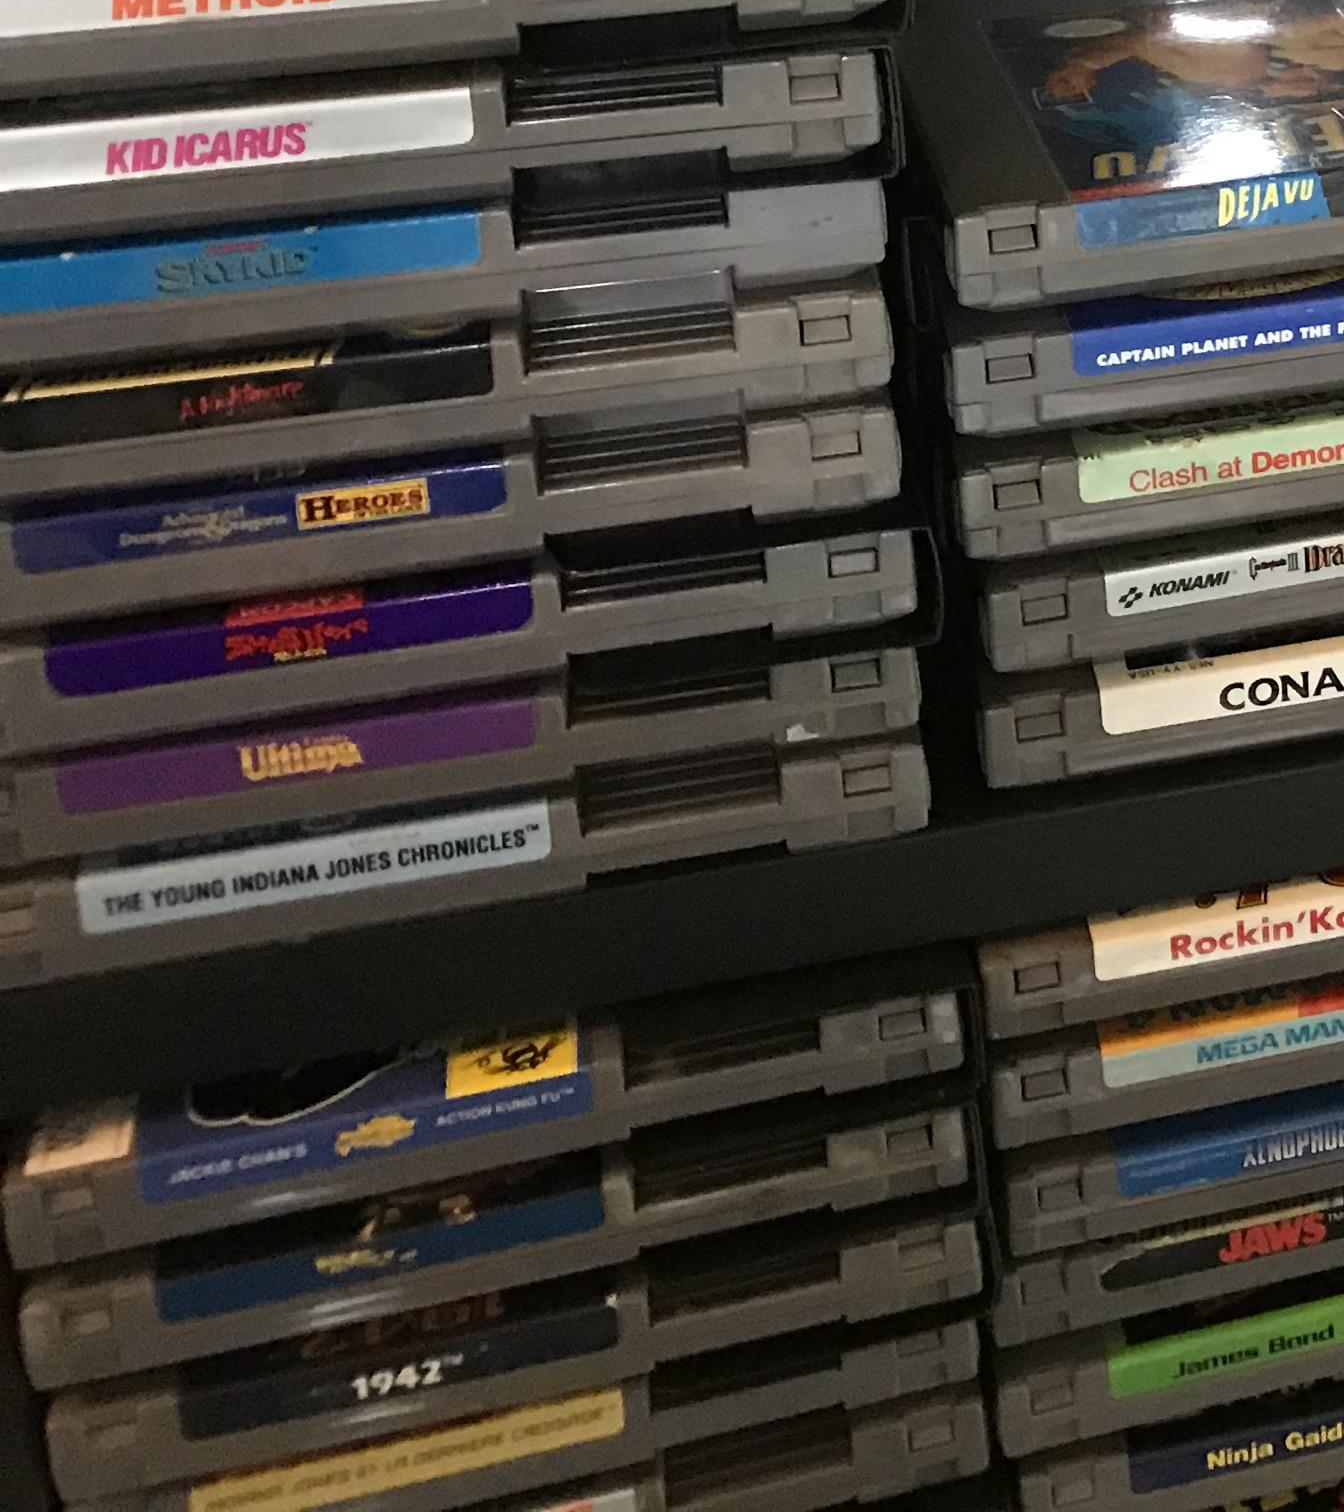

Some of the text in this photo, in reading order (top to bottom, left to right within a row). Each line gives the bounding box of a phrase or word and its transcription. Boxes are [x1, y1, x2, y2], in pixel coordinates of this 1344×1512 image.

[106, 123, 307, 175] KID ICARUS
[1284, 178, 1314, 204] VU
[1097, 345, 1174, 369] CAPTAIN
[1181, 335, 1248, 357] PLANET
[1254, 328, 1293, 347] AND
[1299, 323, 1331, 340] THE
[1129, 463, 1207, 493] Clash
[1217, 456, 1242, 480] at
[1148, 570, 1230, 599] KONAMI
[104, 896, 141, 917] THE
[151, 880, 226, 908] YOUNG
[232, 865, 319, 895] INDIANA
[325, 850, 391, 882] JONES
[1196, 1030, 1279, 1065] MEGA
[1218, 1210, 1328, 1265] JAWS
[1172, 1343, 1260, 1380] James
[1268, 1323, 1336, 1357] Bond
[351, 1358, 442, 1400] 1942
[1206, 1439, 1275, 1471] Ninja
